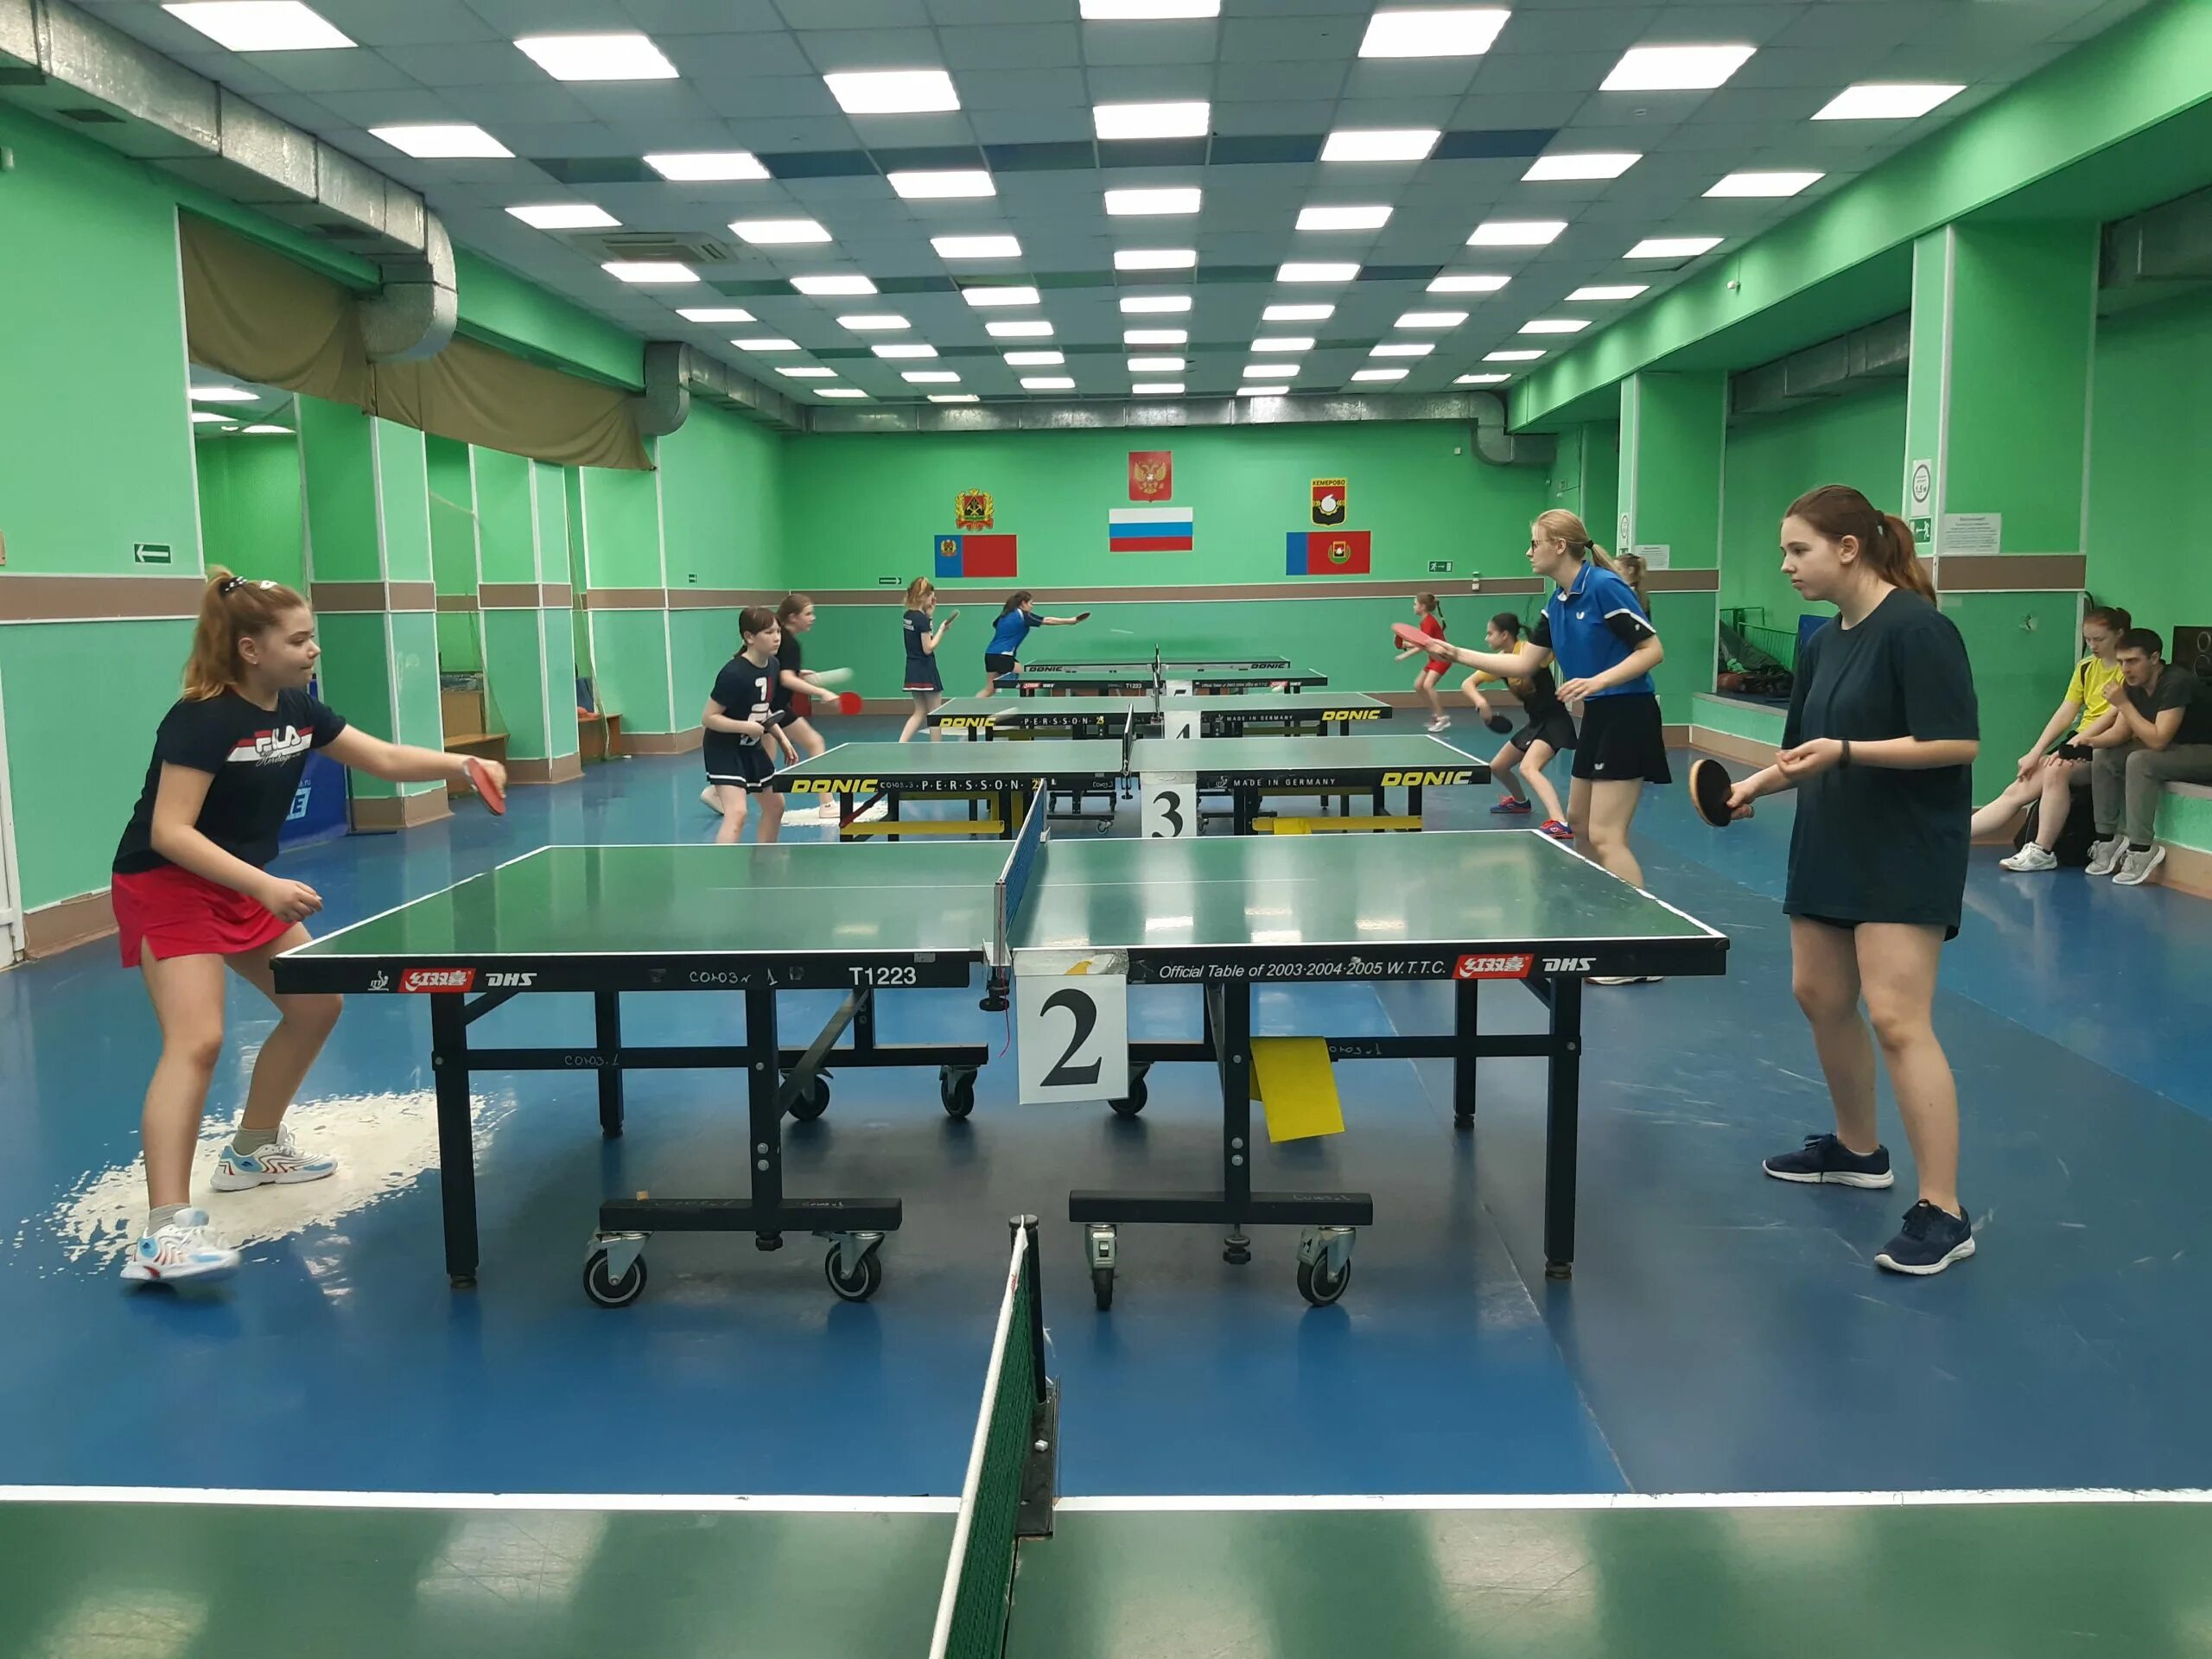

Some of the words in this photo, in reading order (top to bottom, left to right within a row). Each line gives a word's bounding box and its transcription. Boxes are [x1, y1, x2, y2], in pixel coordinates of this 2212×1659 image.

[939, 717, 996, 728] DONIC
[1321, 709, 1381, 721] DONIC
[255, 725, 302, 753] FILA
[791, 779, 878, 793] DONIC
[1285, 778, 1335, 786] GERMANY
[1381, 771, 1473, 786] DONIC
[1151, 790, 1184, 837] 3
[1159, 964, 1205, 979] Official
[1208, 963, 1245, 978] Table
[1249, 963, 1265, 977] of
[1542, 957, 1597, 972] DHS
[485, 972, 537, 987] DHS
[849, 966, 917, 985] T1223
[1039, 988, 1103, 1087] 2
